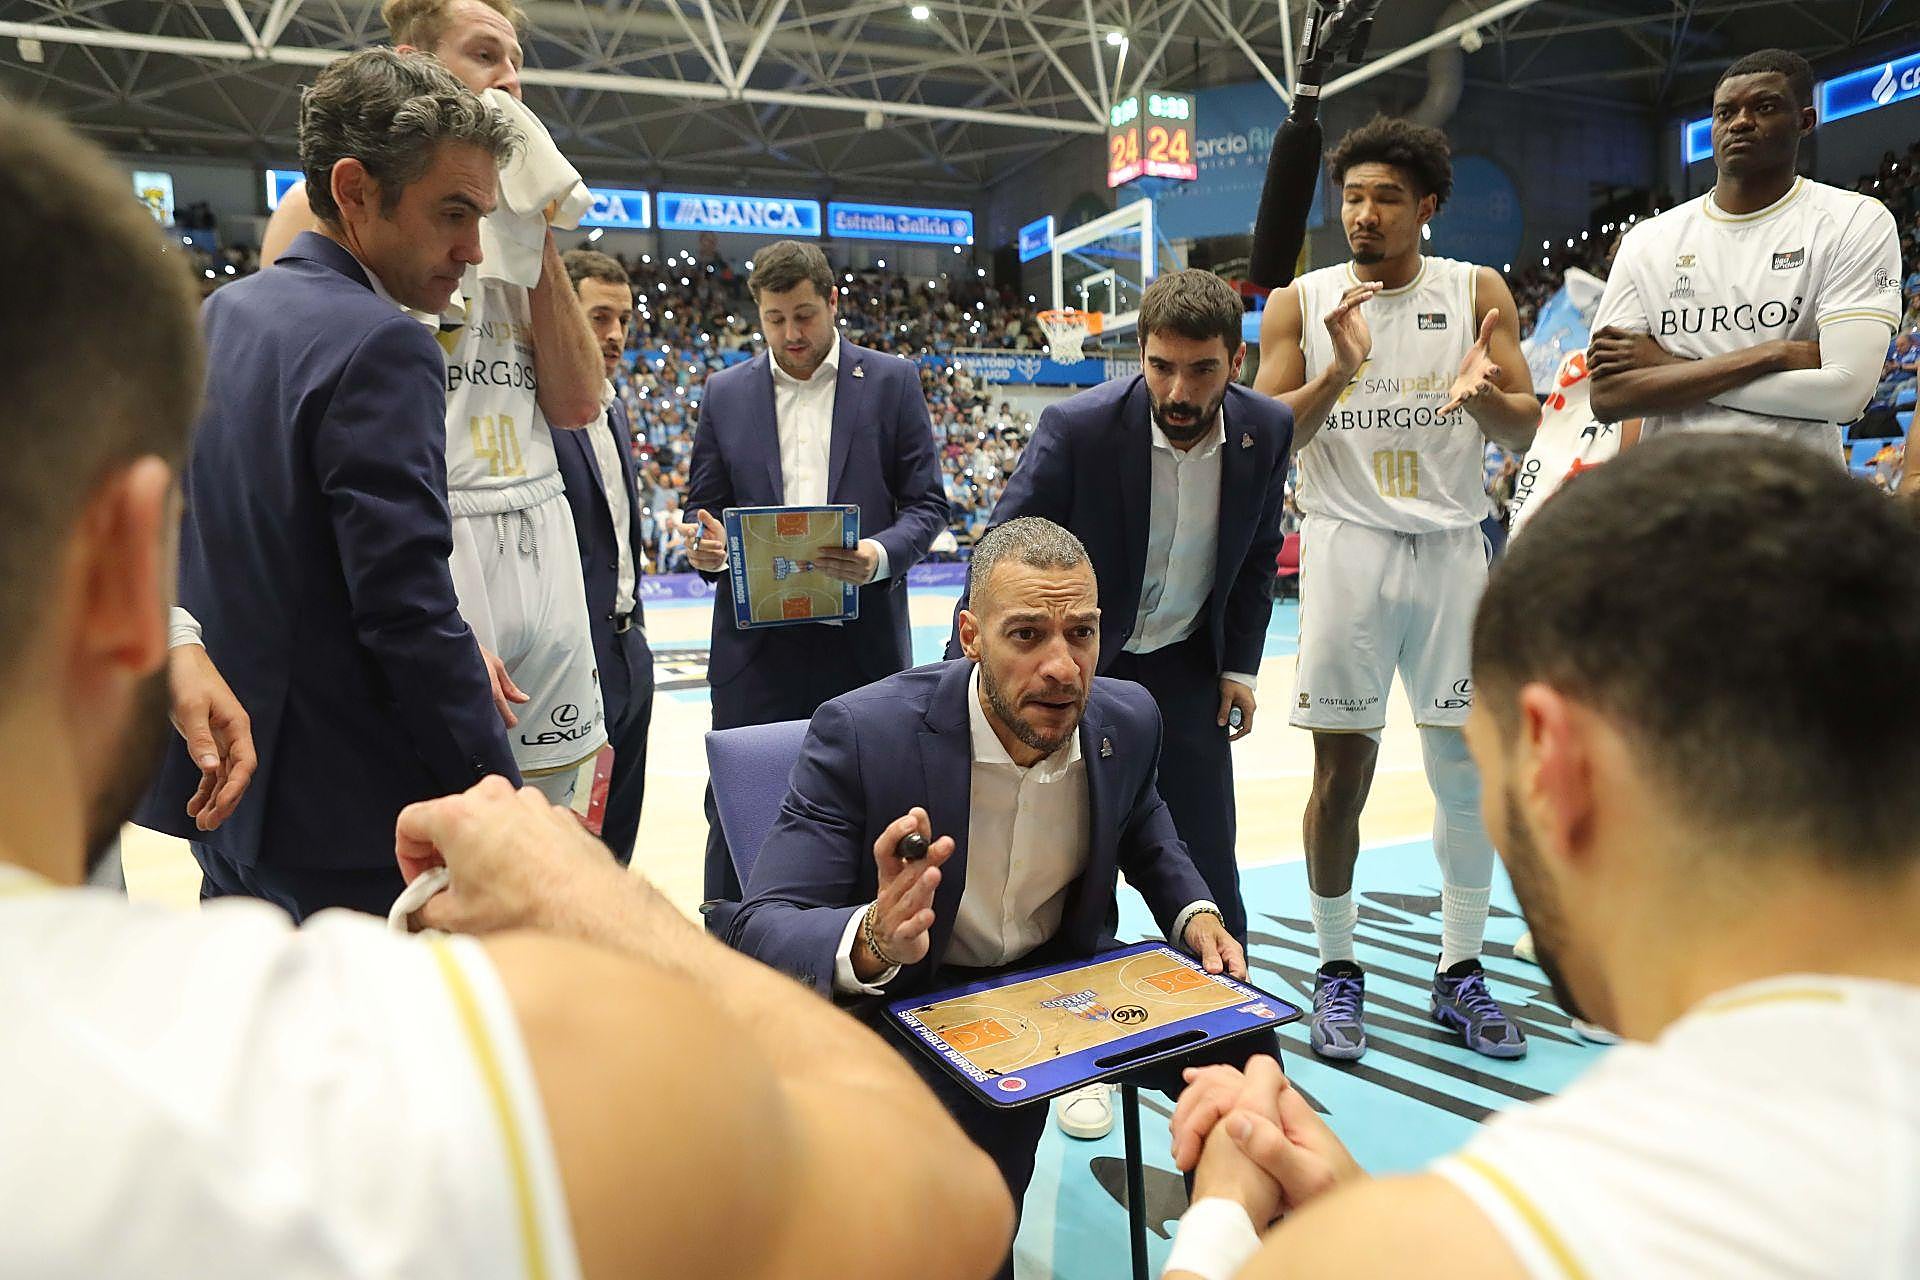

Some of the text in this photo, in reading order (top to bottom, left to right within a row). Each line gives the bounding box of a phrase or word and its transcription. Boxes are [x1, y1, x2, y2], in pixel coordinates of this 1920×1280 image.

[1111, 128, 1139, 170] 24
[1148, 126, 1190, 164] 24
[1197, 133, 1249, 158] arcia
[677, 199, 802, 229] ABANCA
[836, 211, 894, 231] Estrella
[1661, 296, 1802, 336] BURGOS
[1341, 406, 1447, 430] BURGOS
[470, 414, 527, 477] 40
[1373, 450, 1419, 498] 00
[1435, 699, 1472, 709] LEX
[521, 720, 592, 745] LEXUS
[897, 1010, 989, 1083] SAN PABLO BURGOS
